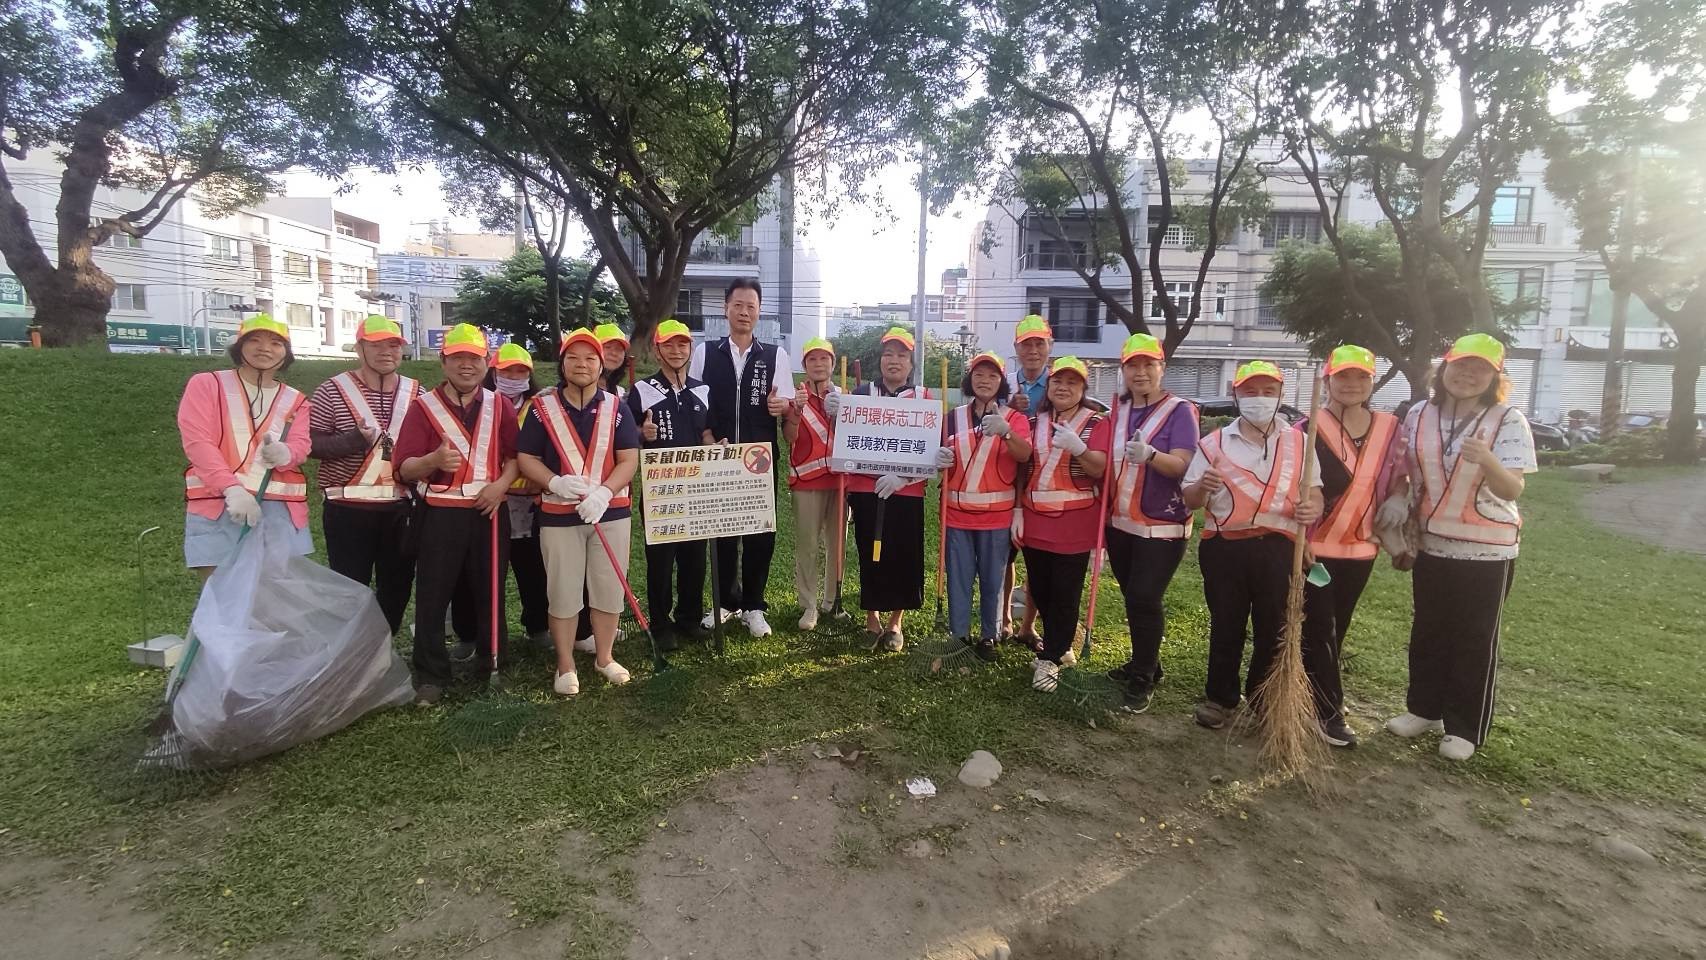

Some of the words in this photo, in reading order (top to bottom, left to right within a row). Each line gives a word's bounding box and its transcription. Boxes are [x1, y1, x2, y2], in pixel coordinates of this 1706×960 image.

[649, 378, 670, 395] FILA
[841, 405, 938, 430] 孔門環保志工隊
[846, 435, 927, 455] 環境教育宣導
[644, 446, 743, 465] 家鼠防除行動!
[856, 462, 914, 474] 臺中市政府環境保護局
[649, 483, 684, 497] 不讓鼠來
[650, 503, 685, 516] 不讓鼠吃
[651, 523, 686, 537] 不讓鼠住
